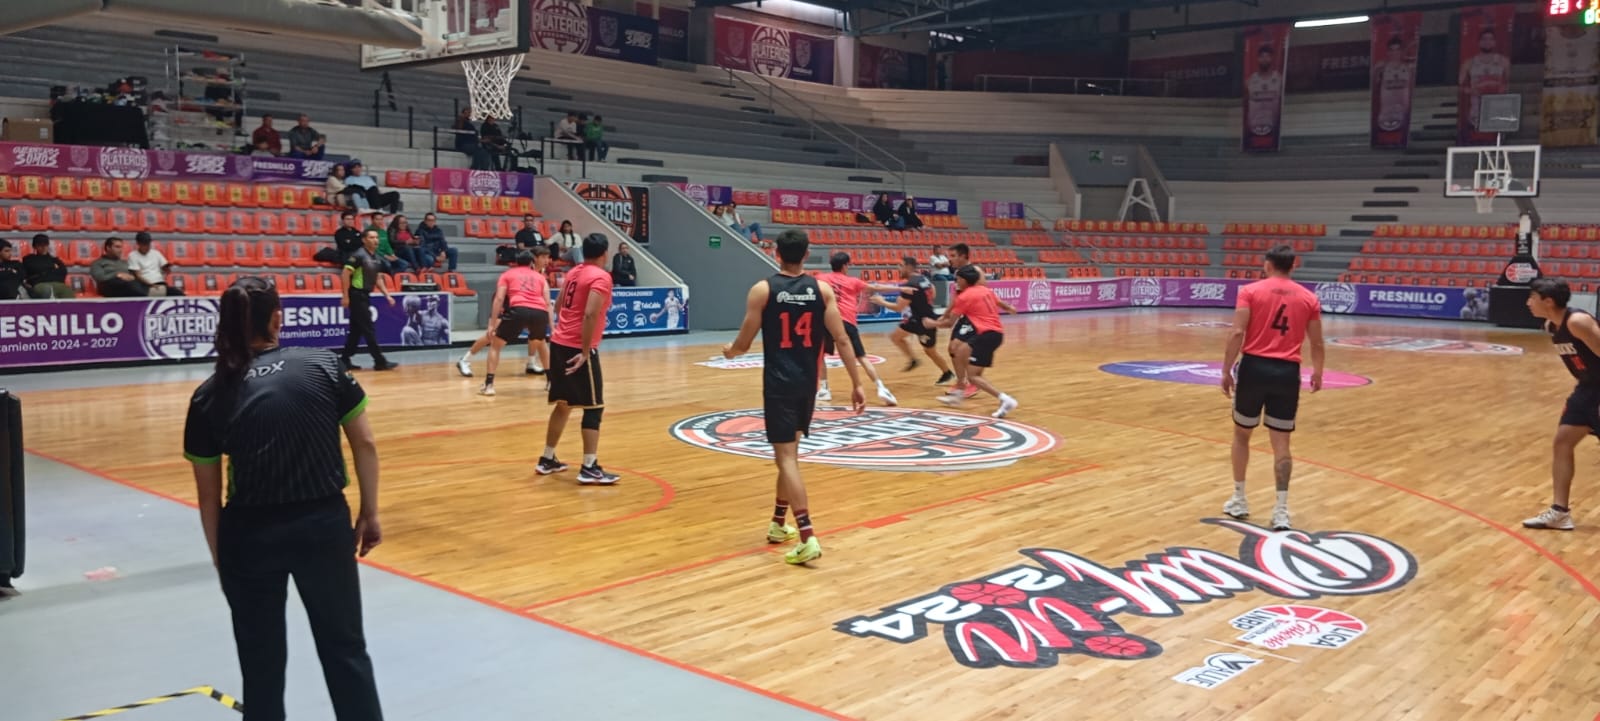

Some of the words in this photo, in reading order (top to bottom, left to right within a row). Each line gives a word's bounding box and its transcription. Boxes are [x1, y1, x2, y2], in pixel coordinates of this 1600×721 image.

[533, 12, 587, 36] PLATEROS
[751, 42, 790, 60] PLATEROS
[101, 153, 147, 168] PLATEROS
[1055, 285, 1092, 297] FRESNILLO
[1369, 290, 1446, 304] FRESNILLO
[1270, 303, 1290, 337] 4
[323, 328, 346, 337] 2024
[779, 311, 813, 349] 14
[51, 340, 80, 350] 2024
[90, 337, 118, 348] 2027
[243, 360, 285, 381] ADX
[1234, 609, 1280, 630] LNBP
[1309, 629, 1359, 648] LIGA
[1186, 654, 1257, 687] VALUE
